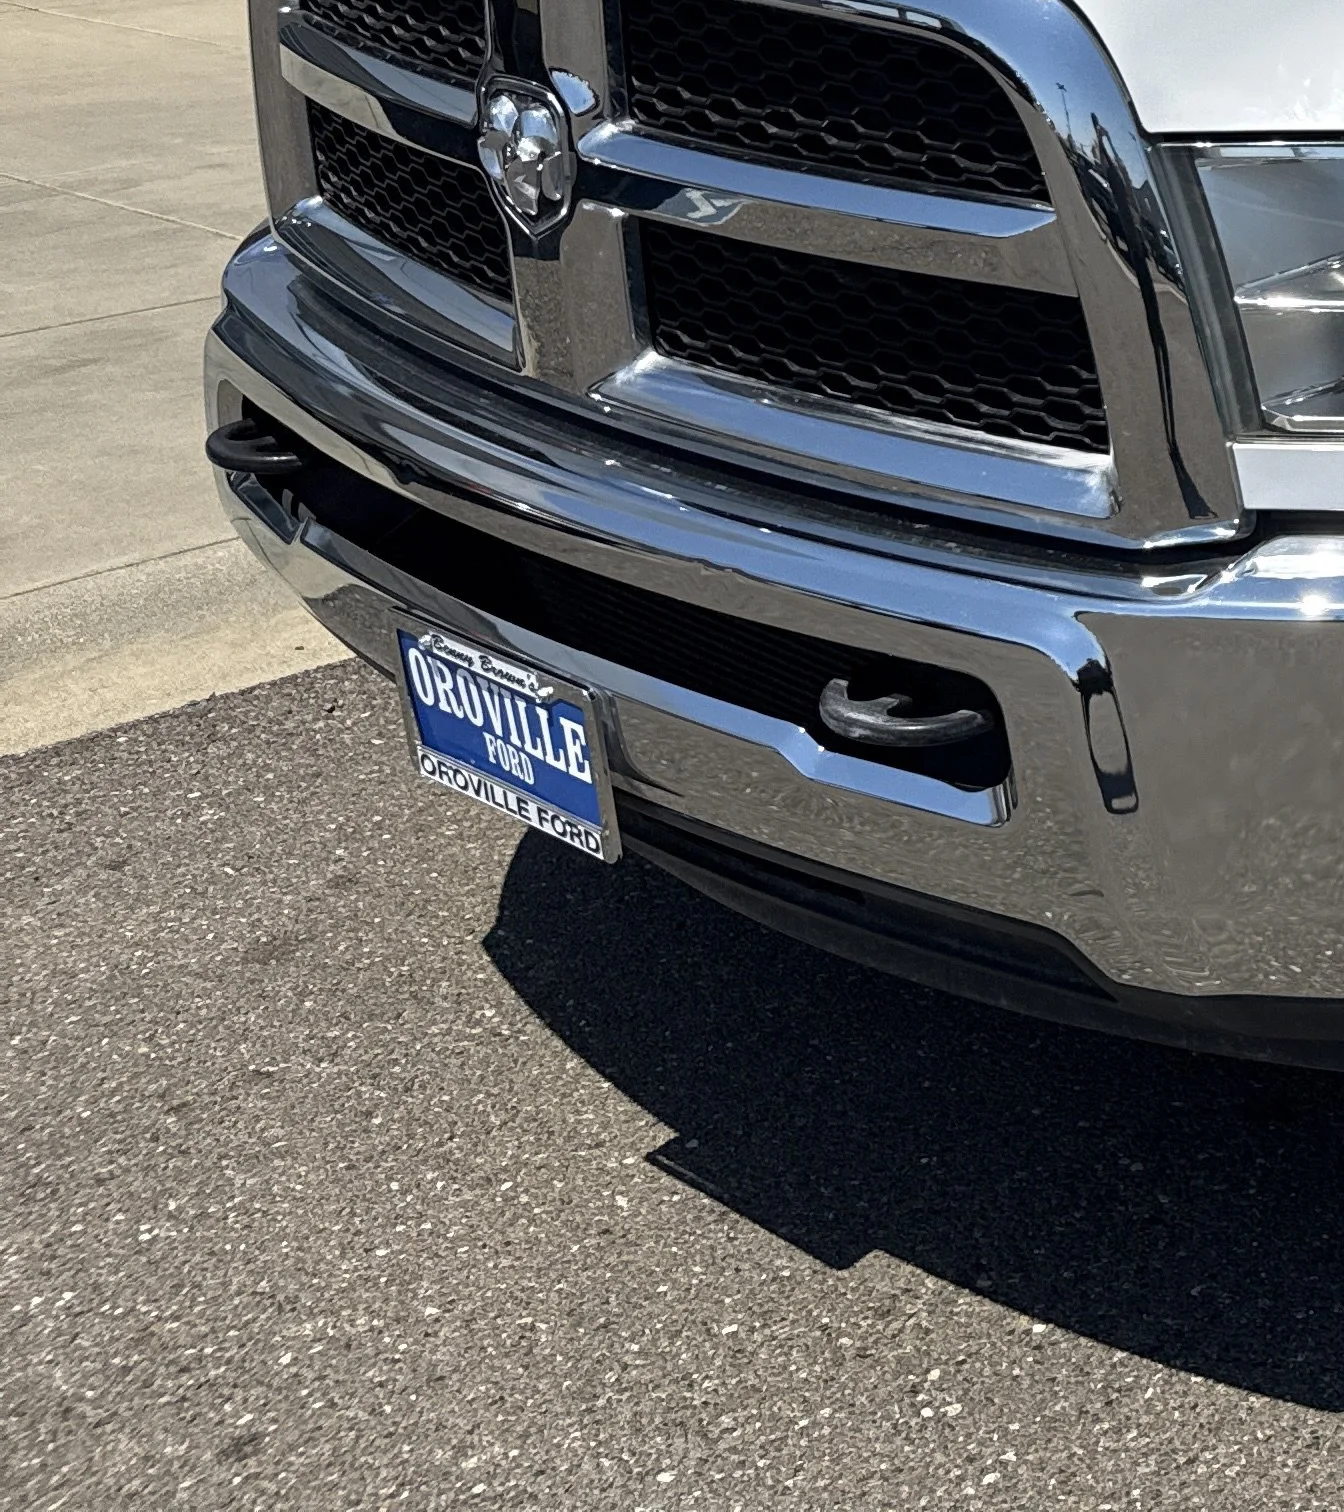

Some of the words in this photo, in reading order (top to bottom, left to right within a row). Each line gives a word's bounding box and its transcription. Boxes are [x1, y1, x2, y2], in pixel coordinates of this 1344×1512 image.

[408, 647, 593, 785] OROVILLE
[482, 731, 535, 785] FORD
[420, 753, 531, 820] OROVILLE
[536, 805, 601, 855] FORD
